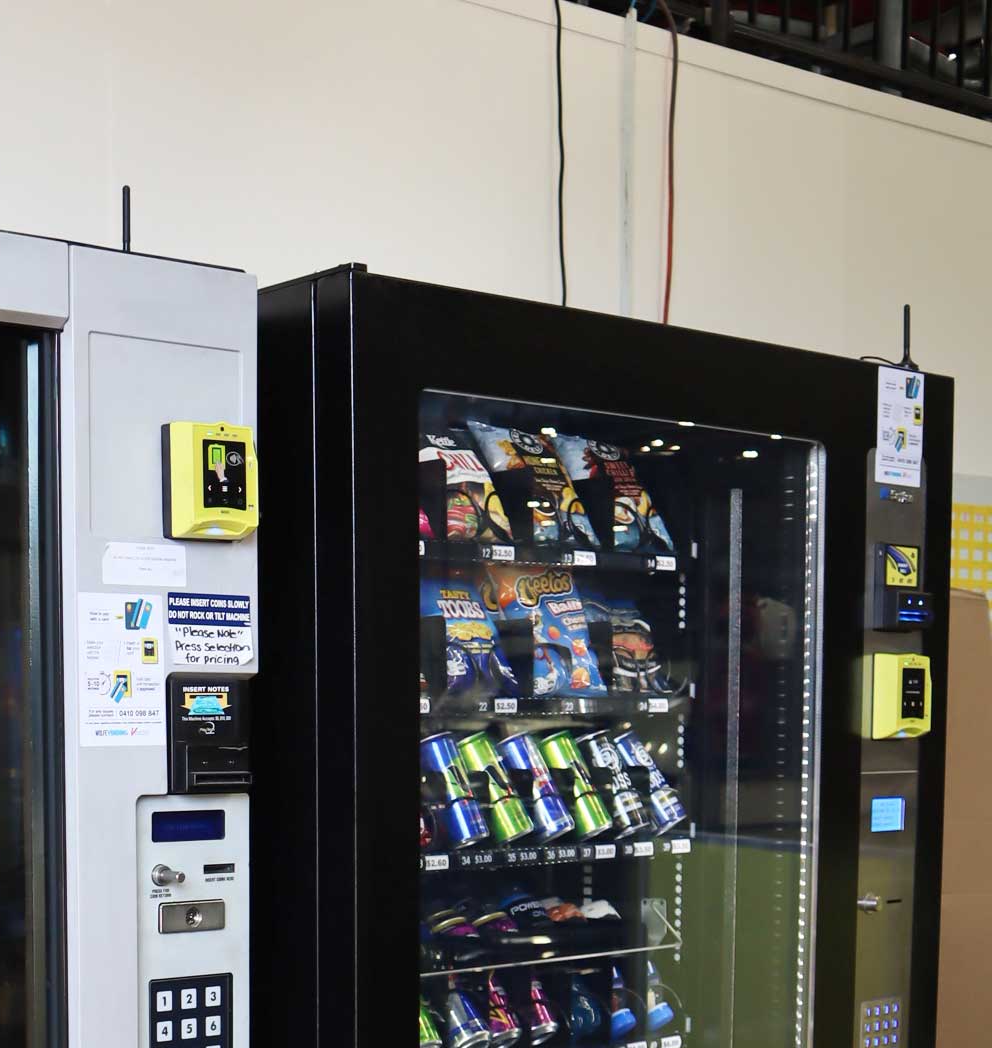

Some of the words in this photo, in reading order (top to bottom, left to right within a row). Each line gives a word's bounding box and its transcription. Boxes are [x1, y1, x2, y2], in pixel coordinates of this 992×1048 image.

[482, 549, 490, 558] 12
[493, 549, 513, 558] $2.50
[168, 597, 190, 606] PLEASE
[190, 598, 210, 608] INSERT
[210, 599, 227, 608] COINS
[228, 600, 249, 610] SLOWLY
[437, 600, 485, 619] TOOBS
[168, 610, 176, 619] DO
[178, 610, 188, 620] NOT
[190, 612, 206, 620] ROCK
[206, 612, 214, 620] OR
[214, 612, 226, 621] TILT
[226, 612, 250, 622] MACHINE
[176, 640, 202, 652] Press
[204, 642, 250, 652] Selection
[186, 654, 200, 663] for
[204, 654, 240, 666] pricing
[479, 702, 488, 712] 22
[496, 702, 516, 711] $2.50
[508, 853, 516, 862] 35
[520, 852, 537, 860] $3.00
[547, 850, 556, 860] 36
[558, 848, 576, 858] $3.00
[584, 848, 592, 858] 37
[462, 856, 470, 866] 34
[475, 854, 492, 864] $3.00
[162, 996, 166, 1006] 1
[186, 994, 192, 1004] 2
[210, 992, 216, 1002] 3
[162, 1026, 168, 1036] 4
[186, 1024, 192, 1034] 5
[210, 1021, 216, 1031] 6
